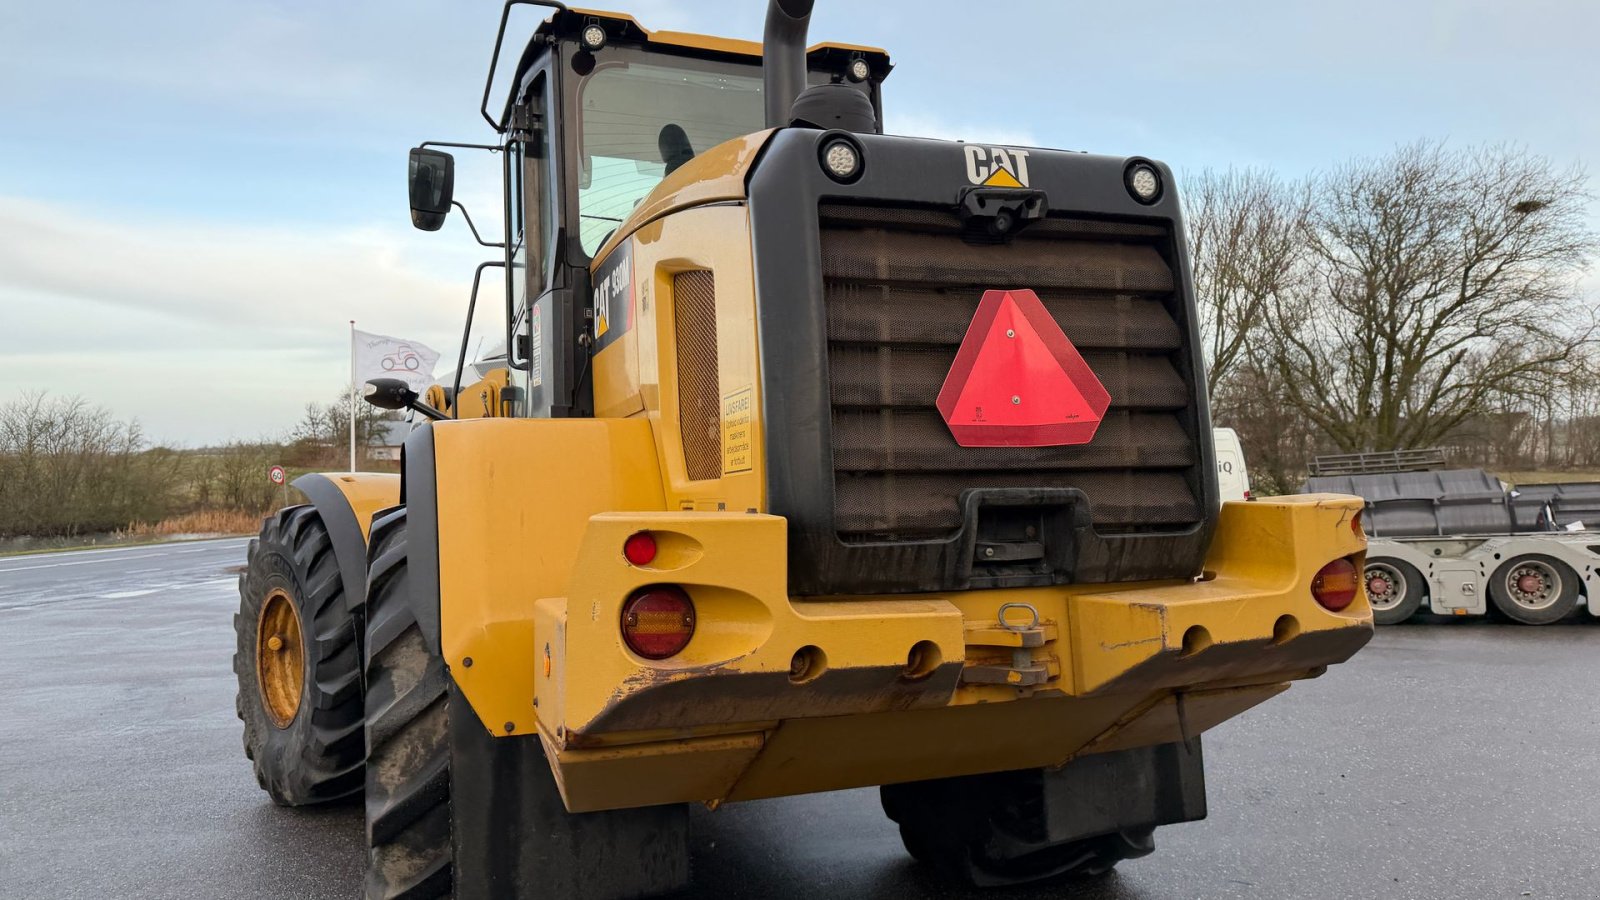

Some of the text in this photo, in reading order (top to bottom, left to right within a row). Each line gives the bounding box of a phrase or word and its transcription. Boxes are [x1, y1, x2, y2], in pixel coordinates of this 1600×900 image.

[964, 145, 1030, 188] CAT
[593, 256, 630, 340] CAT 930M
[272, 471, 282, 480] 60
